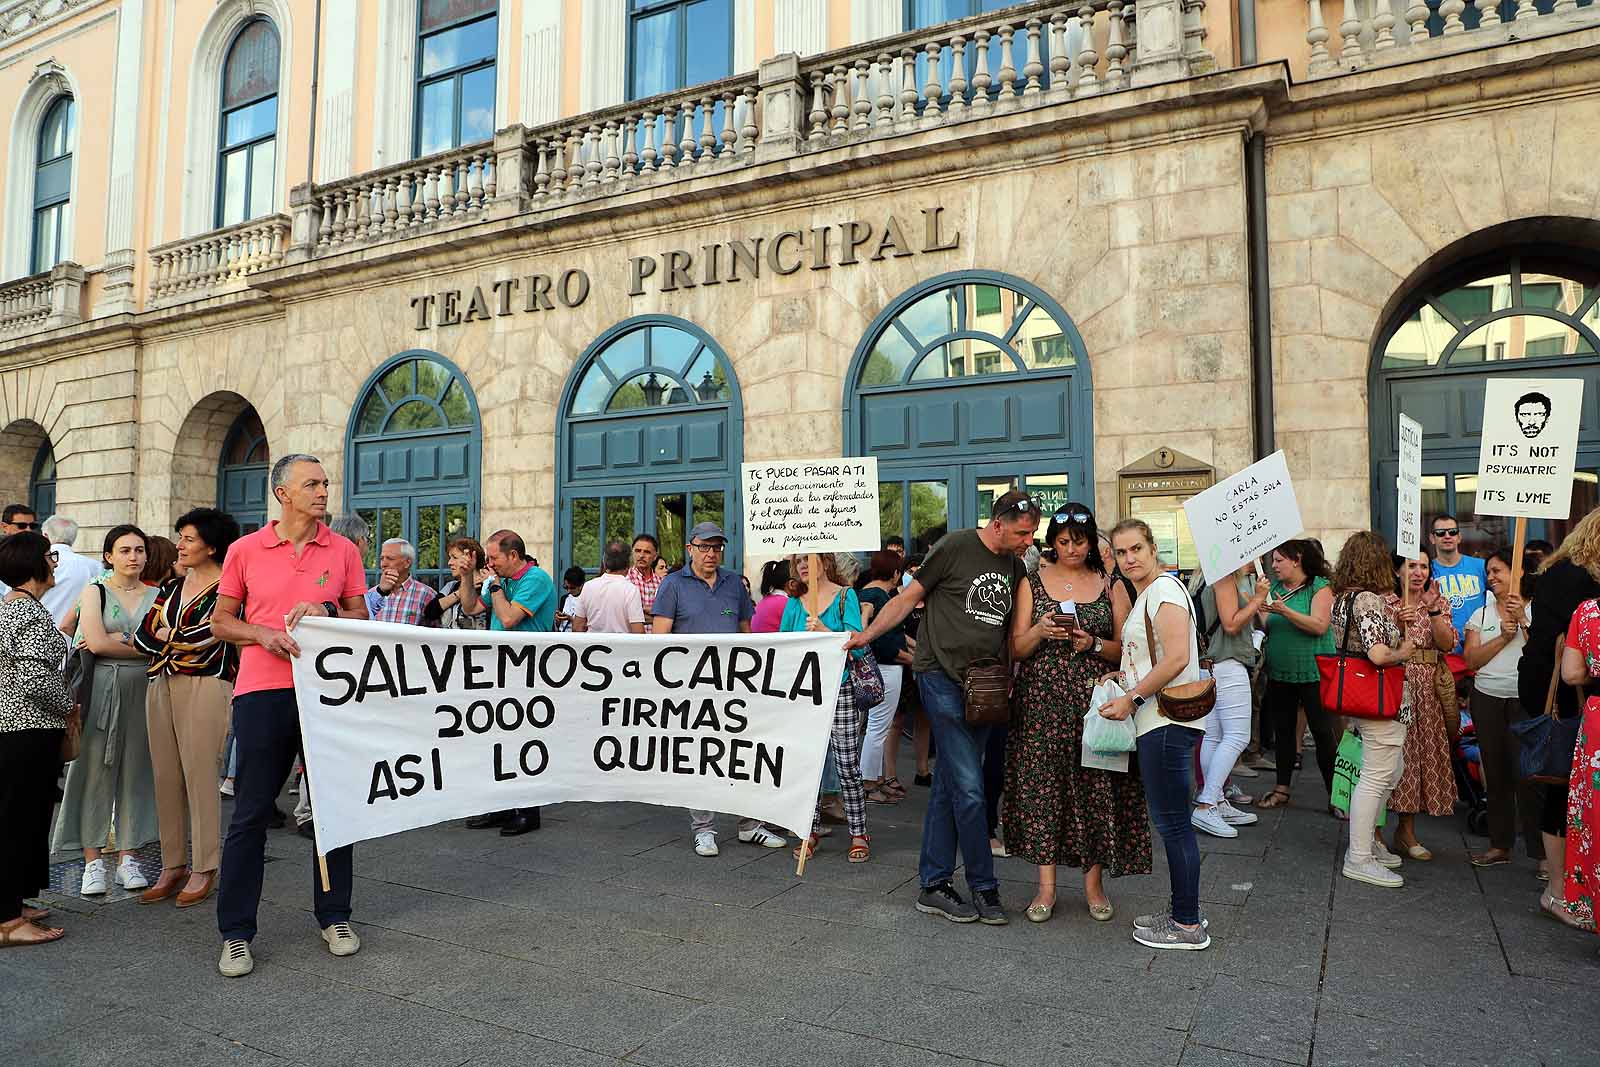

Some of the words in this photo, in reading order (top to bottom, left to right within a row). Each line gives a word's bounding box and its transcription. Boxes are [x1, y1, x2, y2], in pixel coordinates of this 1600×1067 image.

[410, 268, 590, 331] TEATRO
[628, 206, 960, 297] PRINCIPAL
[1493, 445, 1518, 456] IT'S
[1530, 446, 1559, 457] NOT
[749, 470, 762, 479] TE
[766, 468, 798, 478] PUEDE
[804, 466, 839, 476] PASAR
[843, 465, 851, 475] A
[854, 466, 864, 475] TI
[1486, 465, 1556, 474] PSYCHIATRIC
[750, 482, 760, 491] el
[853, 478, 866, 488] de
[1226, 476, 1258, 502] CARLA
[1263, 479, 1282, 495] SOLA
[793, 493, 803, 502] de
[1484, 490, 1505, 501] IT'S
[1517, 492, 1551, 504] LYME
[761, 506, 771, 517] el
[773, 504, 803, 521] orgullo
[809, 506, 819, 514] de
[825, 504, 856, 518] algunos
[1246, 518, 1268, 536] CREO
[762, 536, 775, 544] en
[314, 643, 613, 706] SALVEMOS
[623, 661, 641, 678] a
[653, 645, 822, 705] CARLA
[435, 694, 555, 737] 2000
[602, 698, 747, 733] FIRMAS
[368, 748, 442, 804] ASI
[494, 740, 548, 781] LO
[594, 736, 783, 787] QUIEREN
